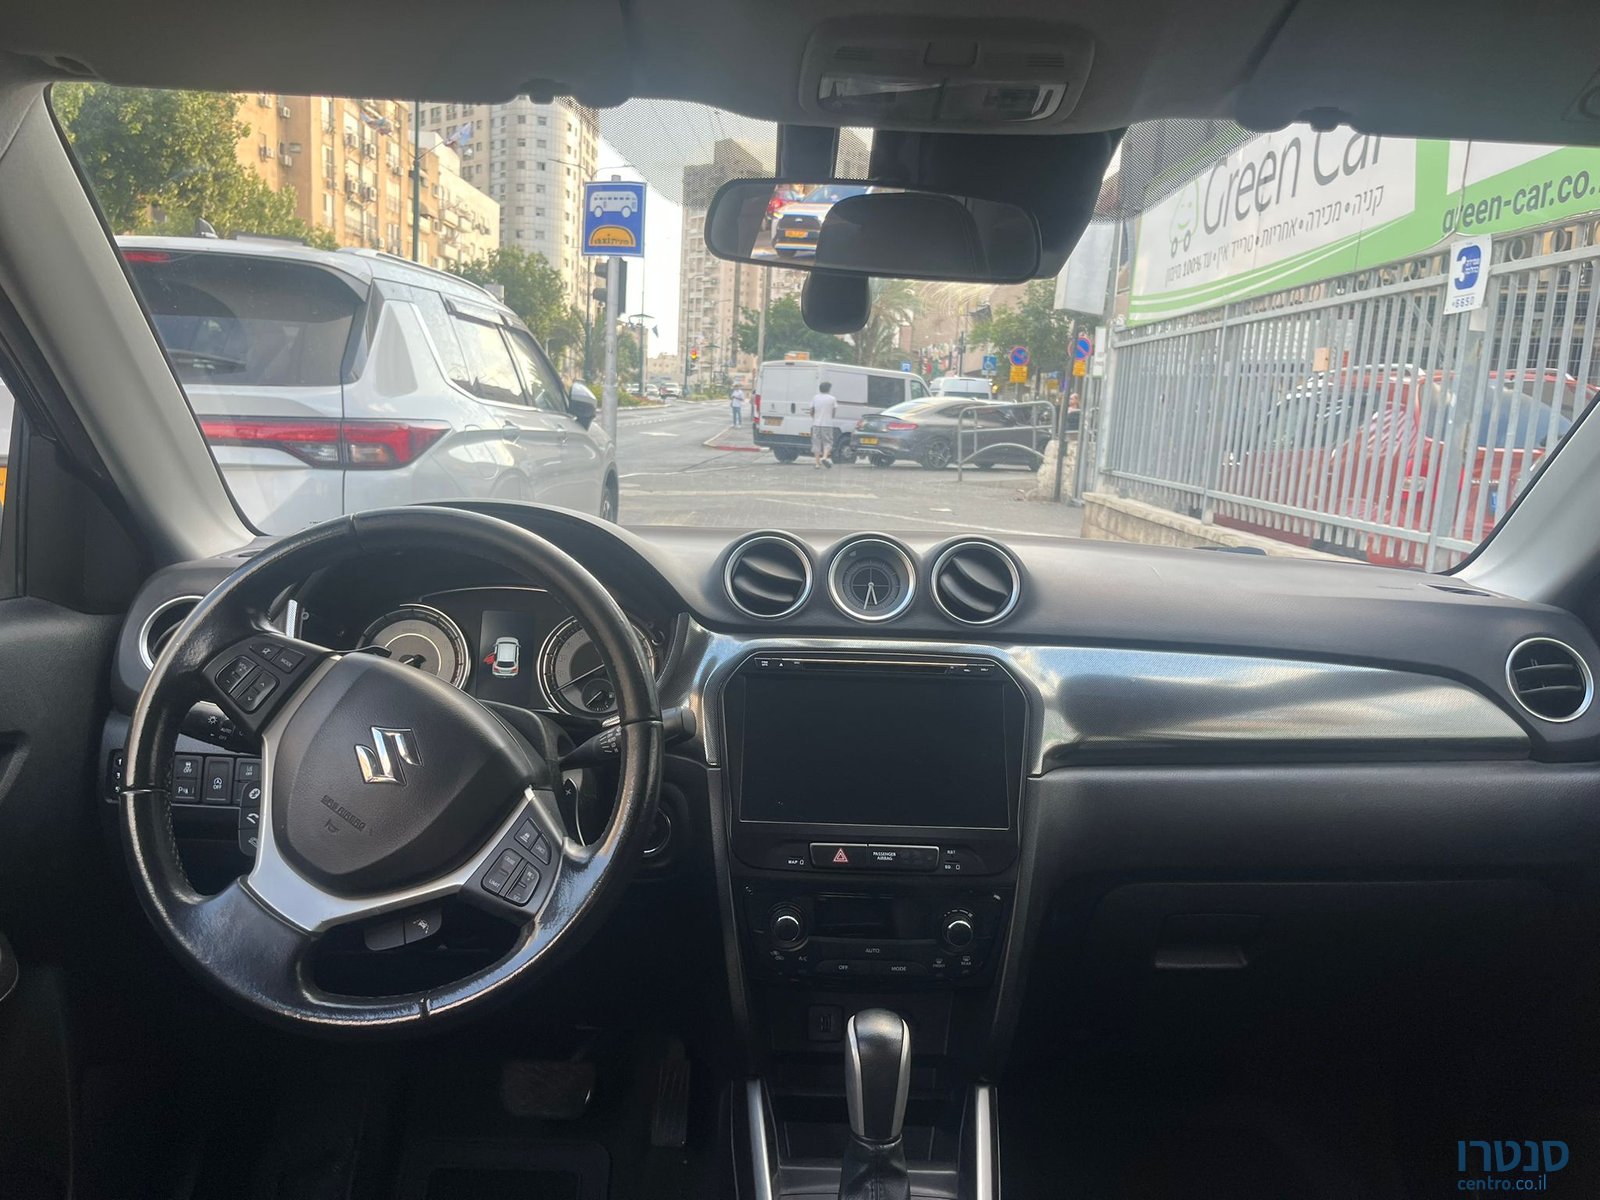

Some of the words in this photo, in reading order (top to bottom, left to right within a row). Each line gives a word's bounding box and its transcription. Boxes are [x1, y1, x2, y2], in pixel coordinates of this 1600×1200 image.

[1203, 137, 1301, 235] Green
[1313, 131, 1382, 186] Car
[1305, 200, 1342, 232] מכירה
[1352, 185, 1384, 216] קניה
[1443, 170, 1600, 235] green-car.co.
[1260, 216, 1298, 248] אחריות
[1182, 255, 1202, 277] 100%
[488, 878, 501, 889] LIMIT
